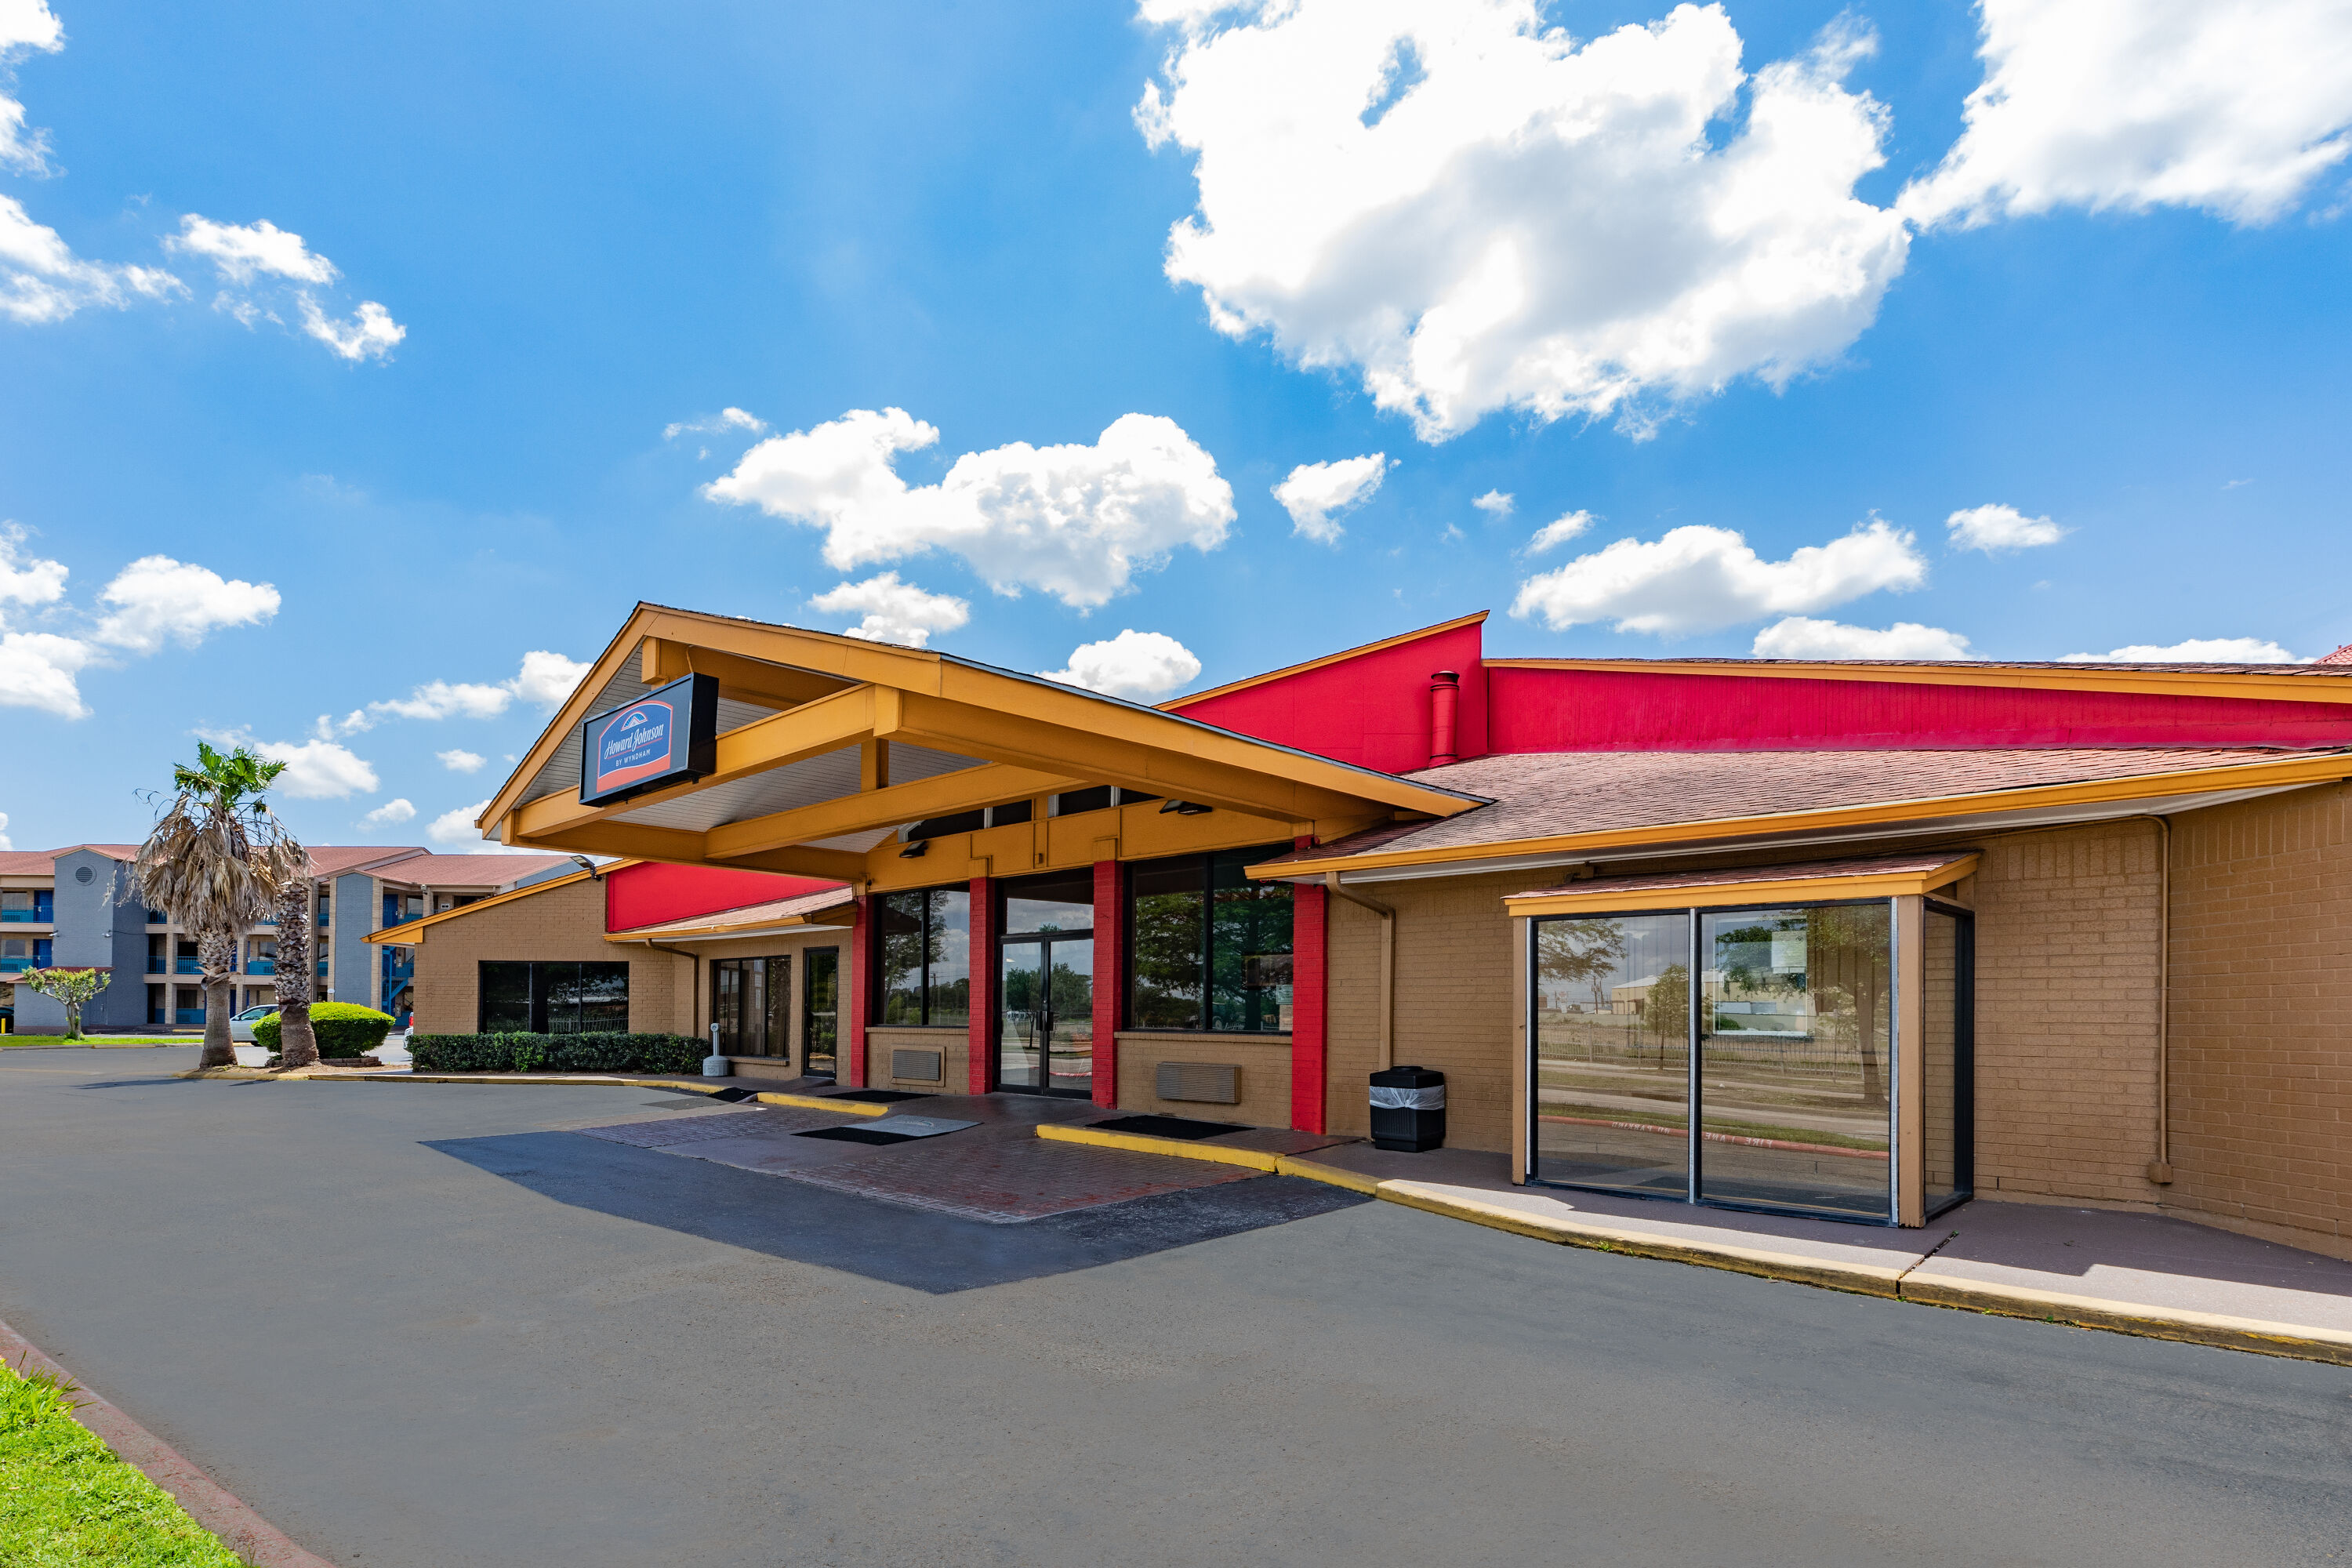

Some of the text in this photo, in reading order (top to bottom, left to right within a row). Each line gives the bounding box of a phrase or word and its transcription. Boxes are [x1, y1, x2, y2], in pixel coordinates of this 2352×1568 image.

[604, 724, 664, 760] Howard Johnson
[615, 749, 651, 767] BY WYNDHAM
